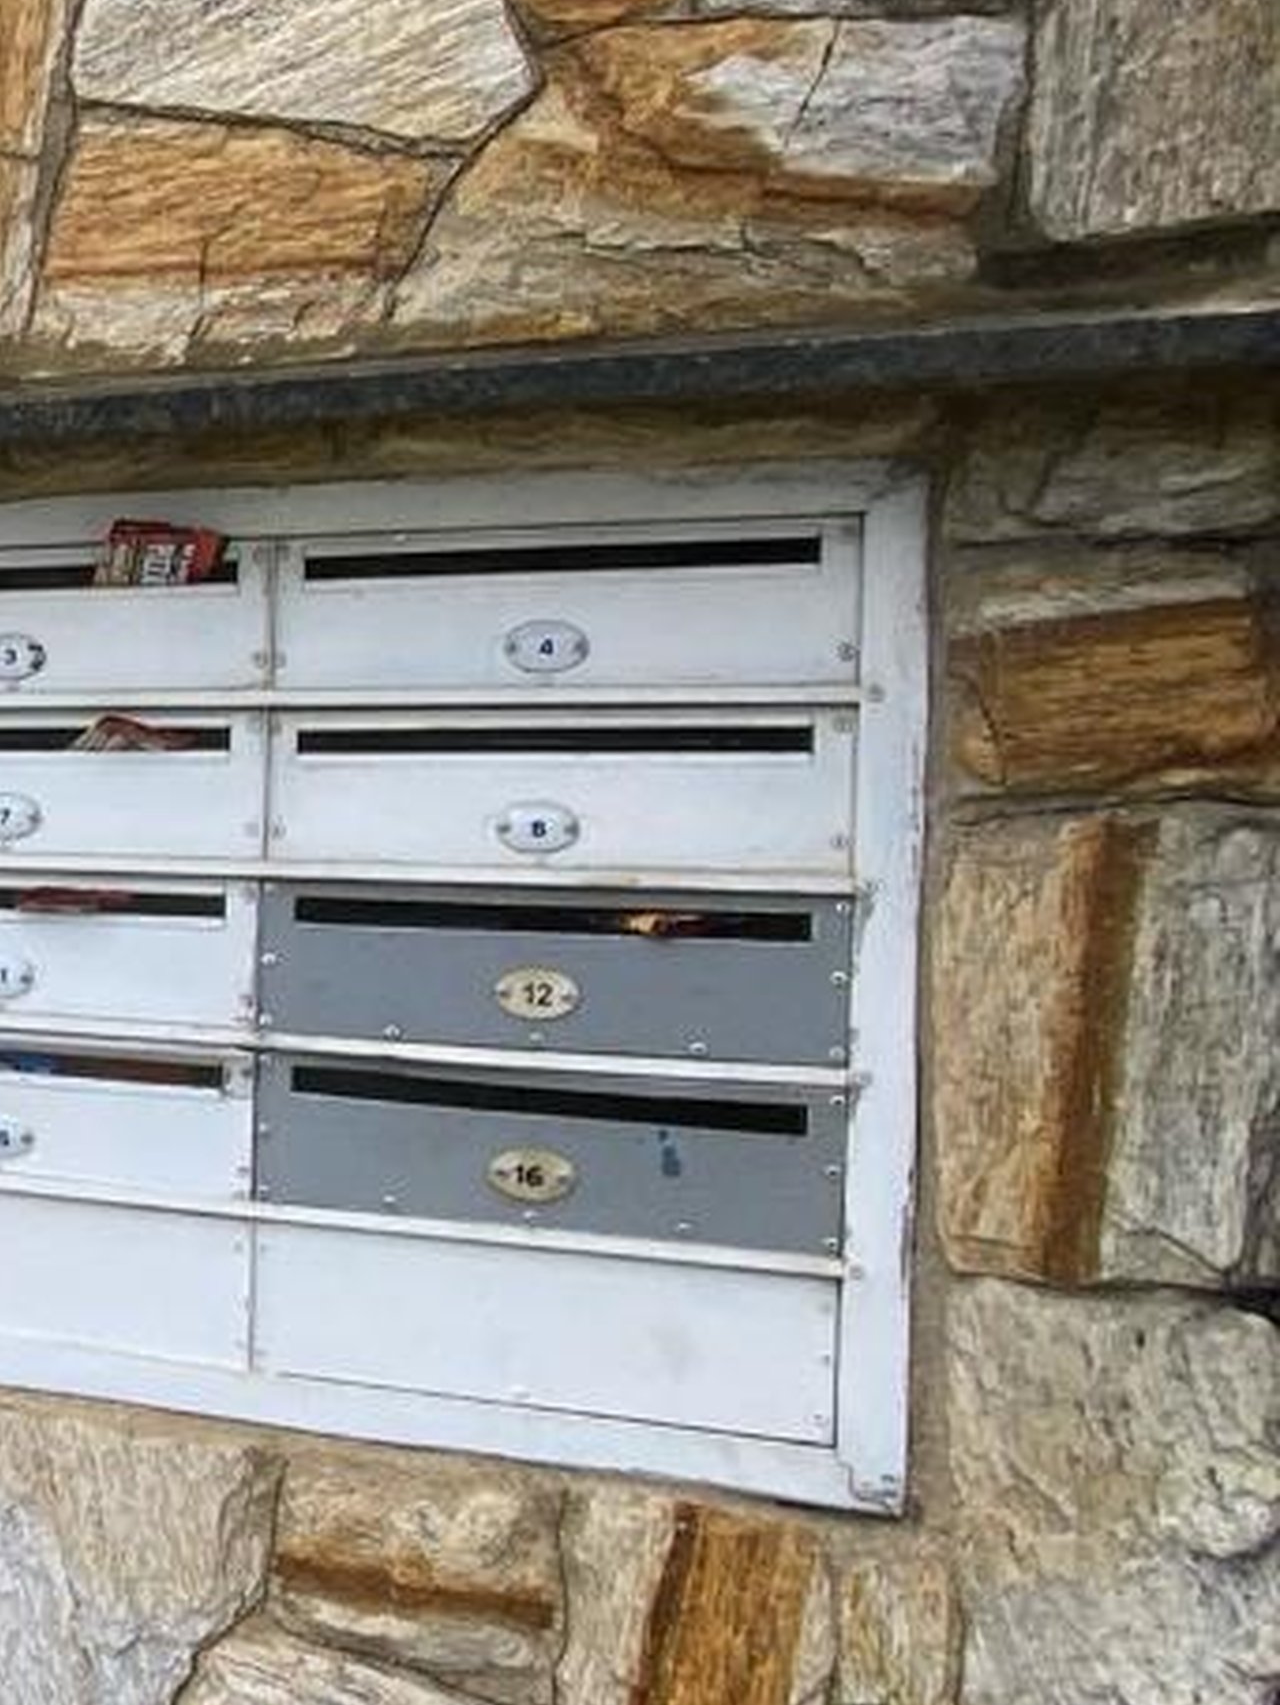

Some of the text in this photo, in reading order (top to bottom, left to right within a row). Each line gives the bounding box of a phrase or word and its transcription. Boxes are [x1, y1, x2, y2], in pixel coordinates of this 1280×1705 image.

[538, 638, 554, 656] 4
[521, 980, 554, 1007] 12
[515, 1164, 545, 1188] 16
